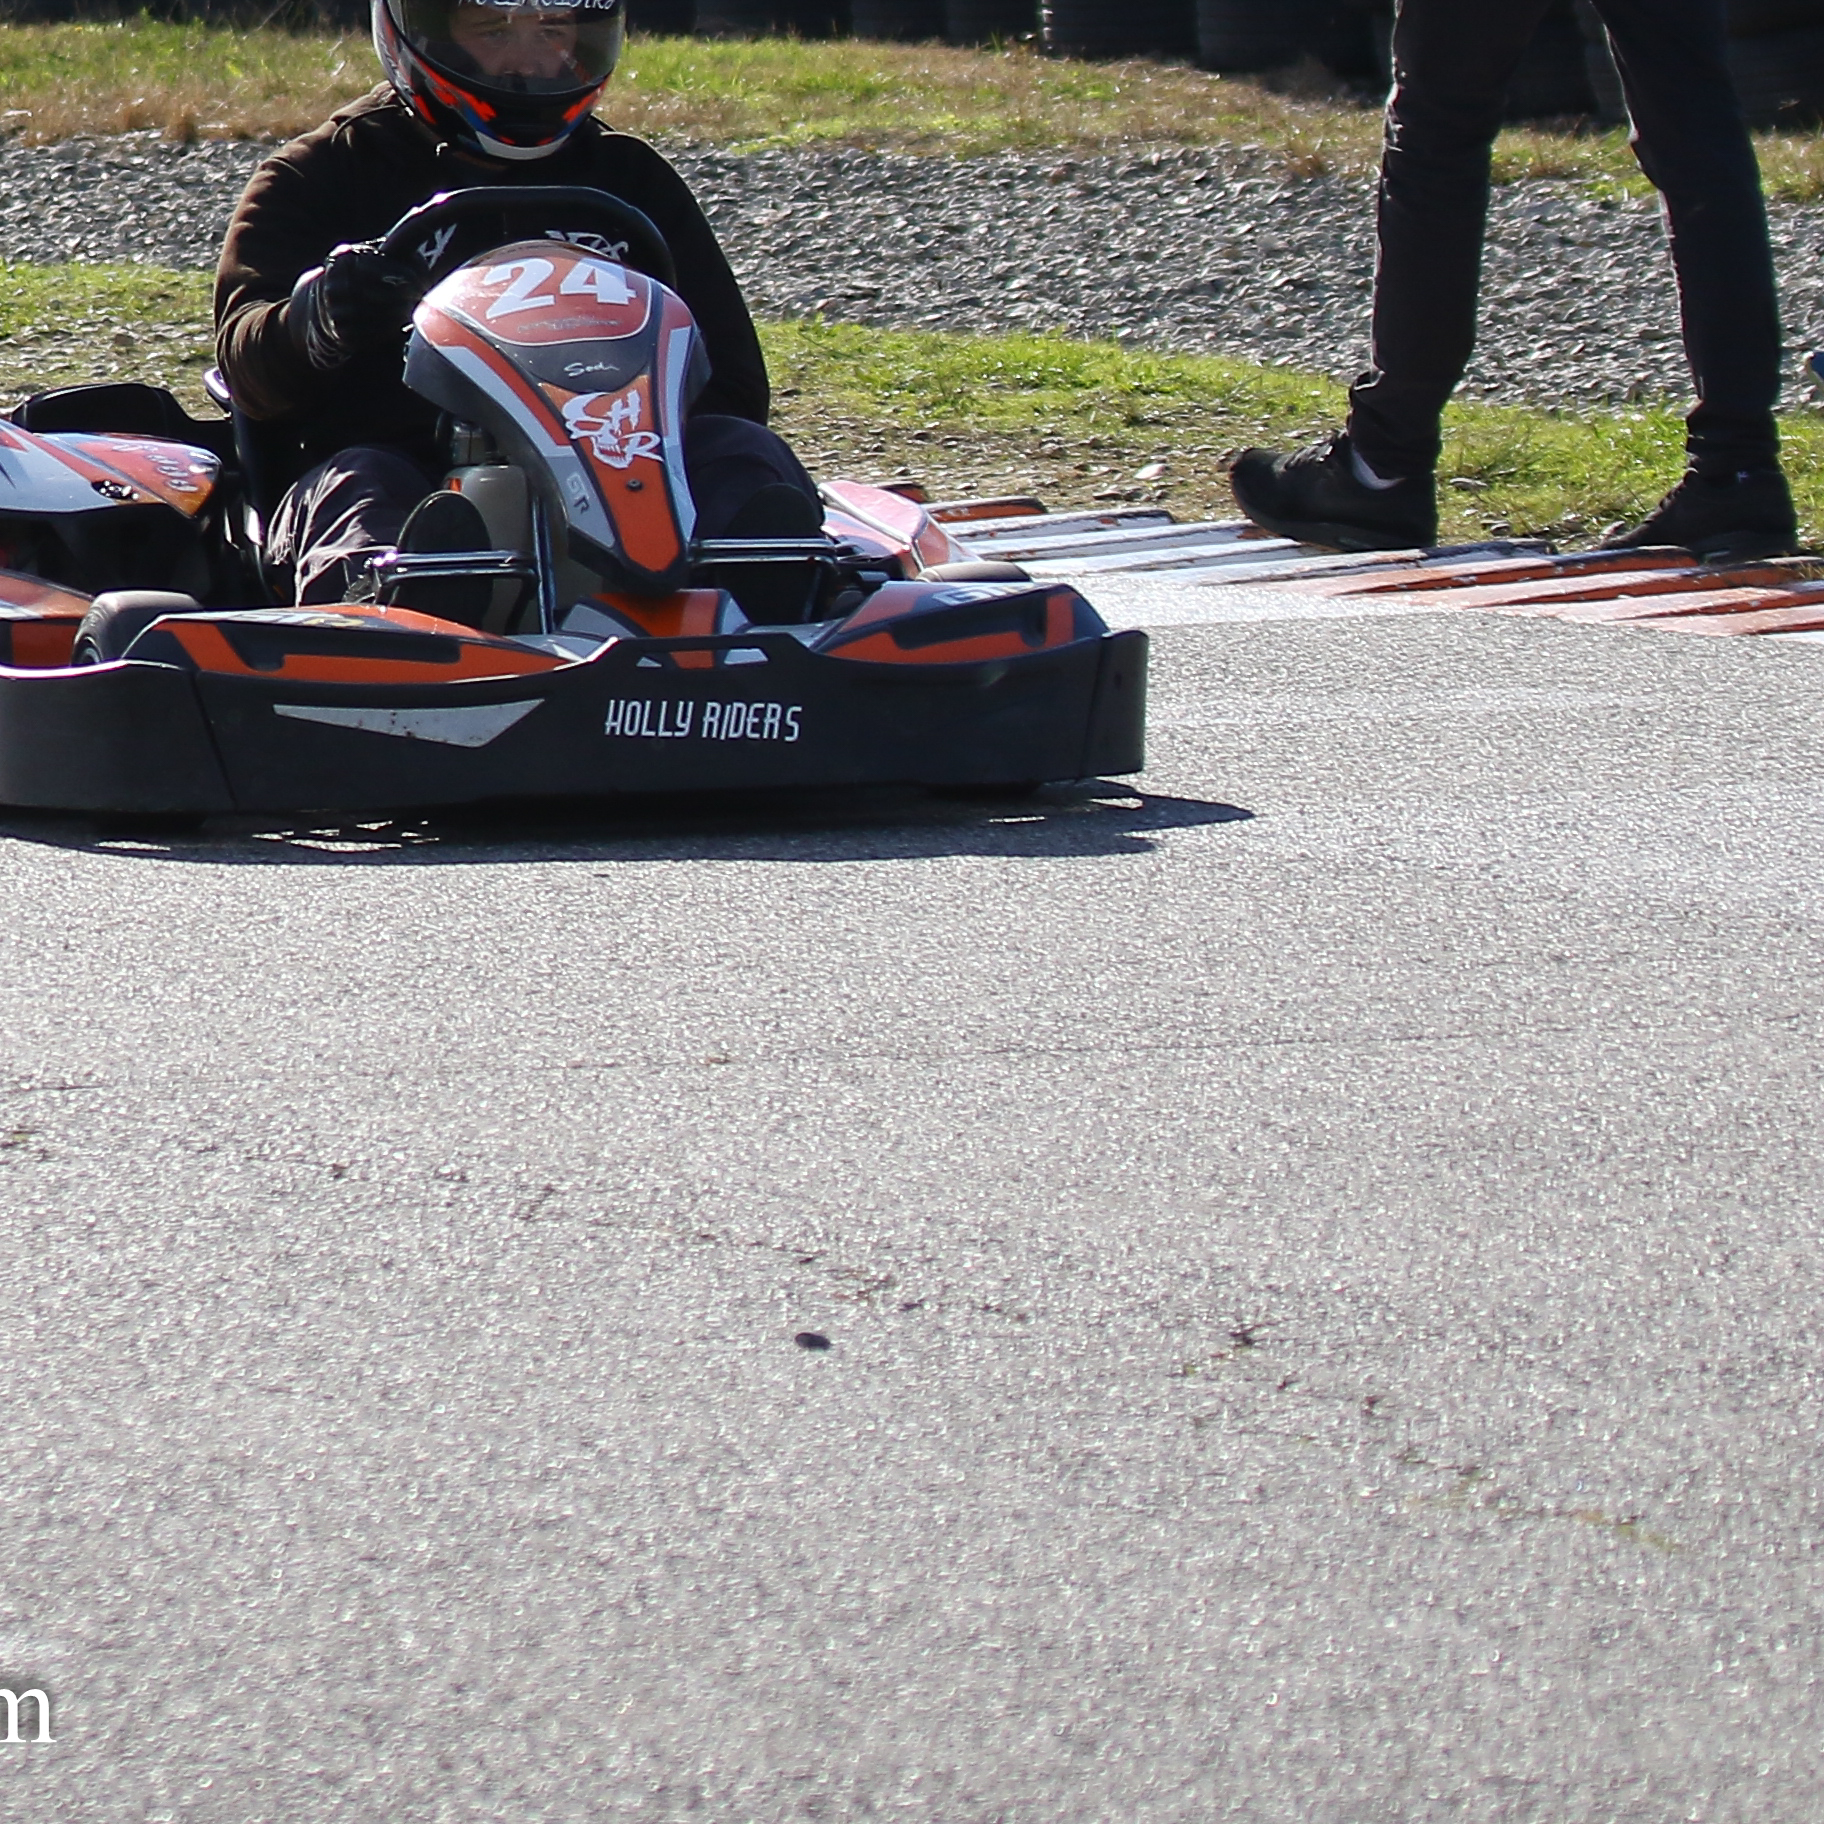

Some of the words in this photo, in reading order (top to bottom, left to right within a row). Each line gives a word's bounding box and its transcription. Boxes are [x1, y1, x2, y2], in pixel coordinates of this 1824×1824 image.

[483, 257, 637, 320] 24
[604, 699, 694, 738] HOLLY
[700, 701, 803, 743] RIDERS
